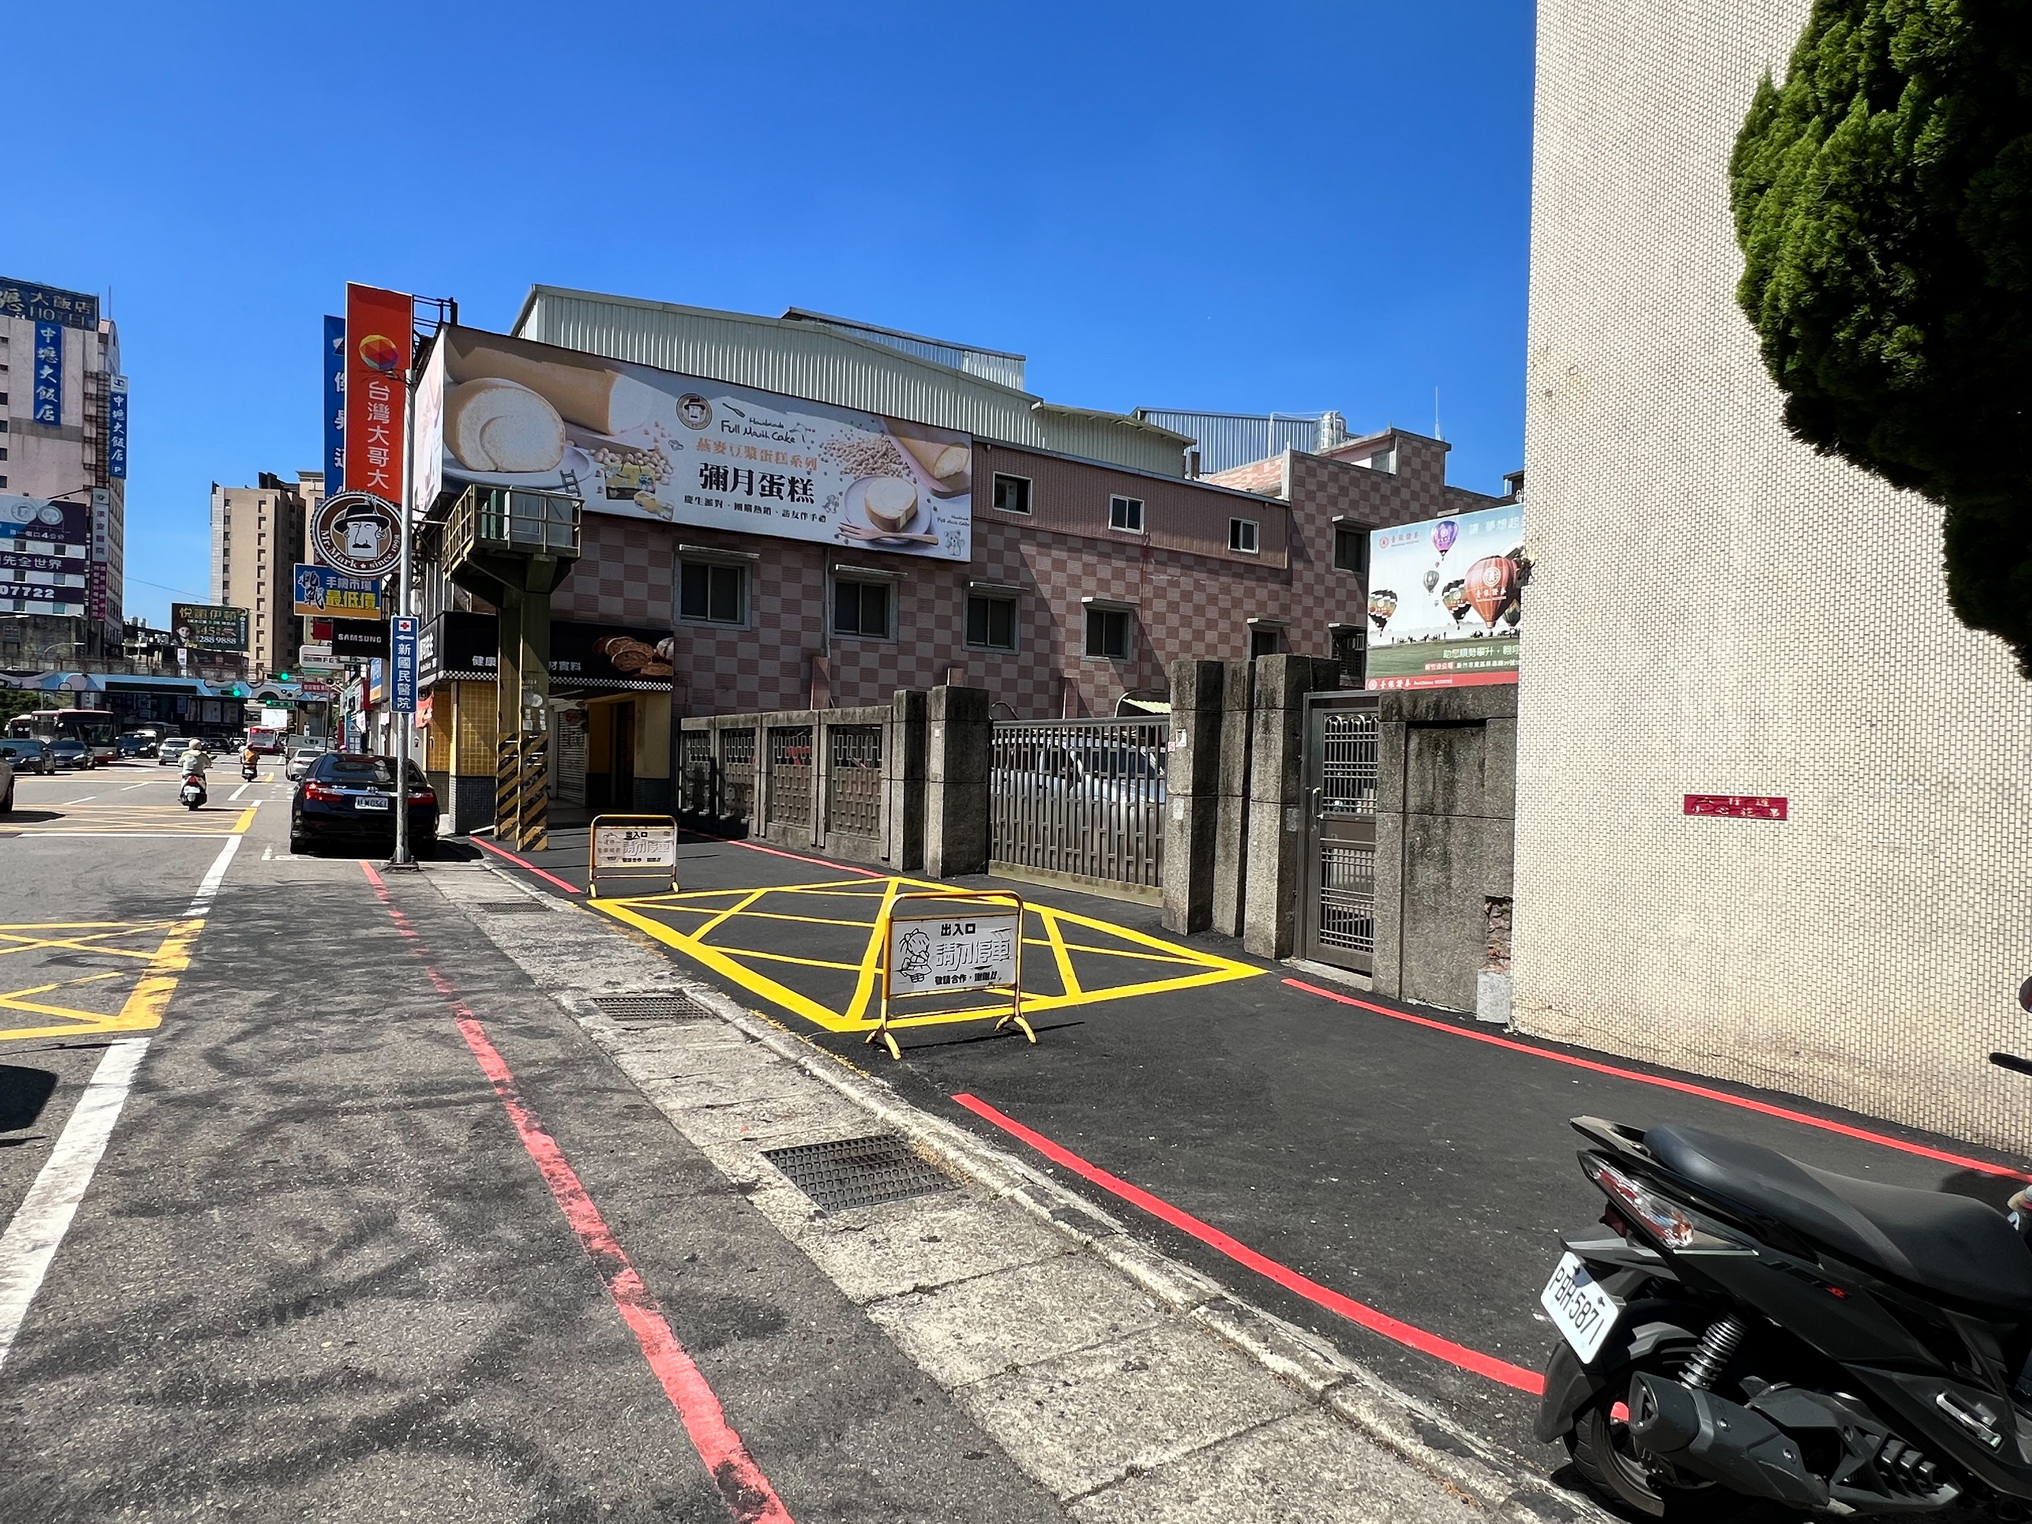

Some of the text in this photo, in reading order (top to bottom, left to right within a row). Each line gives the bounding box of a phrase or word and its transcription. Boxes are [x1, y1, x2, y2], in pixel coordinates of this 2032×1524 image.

[36, 327, 58, 421] 中壢大飯店
[367, 381, 391, 489] 台灣大哥大
[721, 420, 741, 434] Full
[771, 431, 796, 444] Cake
[699, 462, 815, 505] 彌月蛋糕
[0, 554, 62, 570] 先全世界
[369, 553, 393, 569] since
[325, 589, 377, 610] 最低價
[338, 633, 382, 643] SAMSUNG
[397, 643, 412, 709] 新國民醫院
[941, 923, 976, 936] 出入口
[936, 939, 1010, 971] 請勿停車
